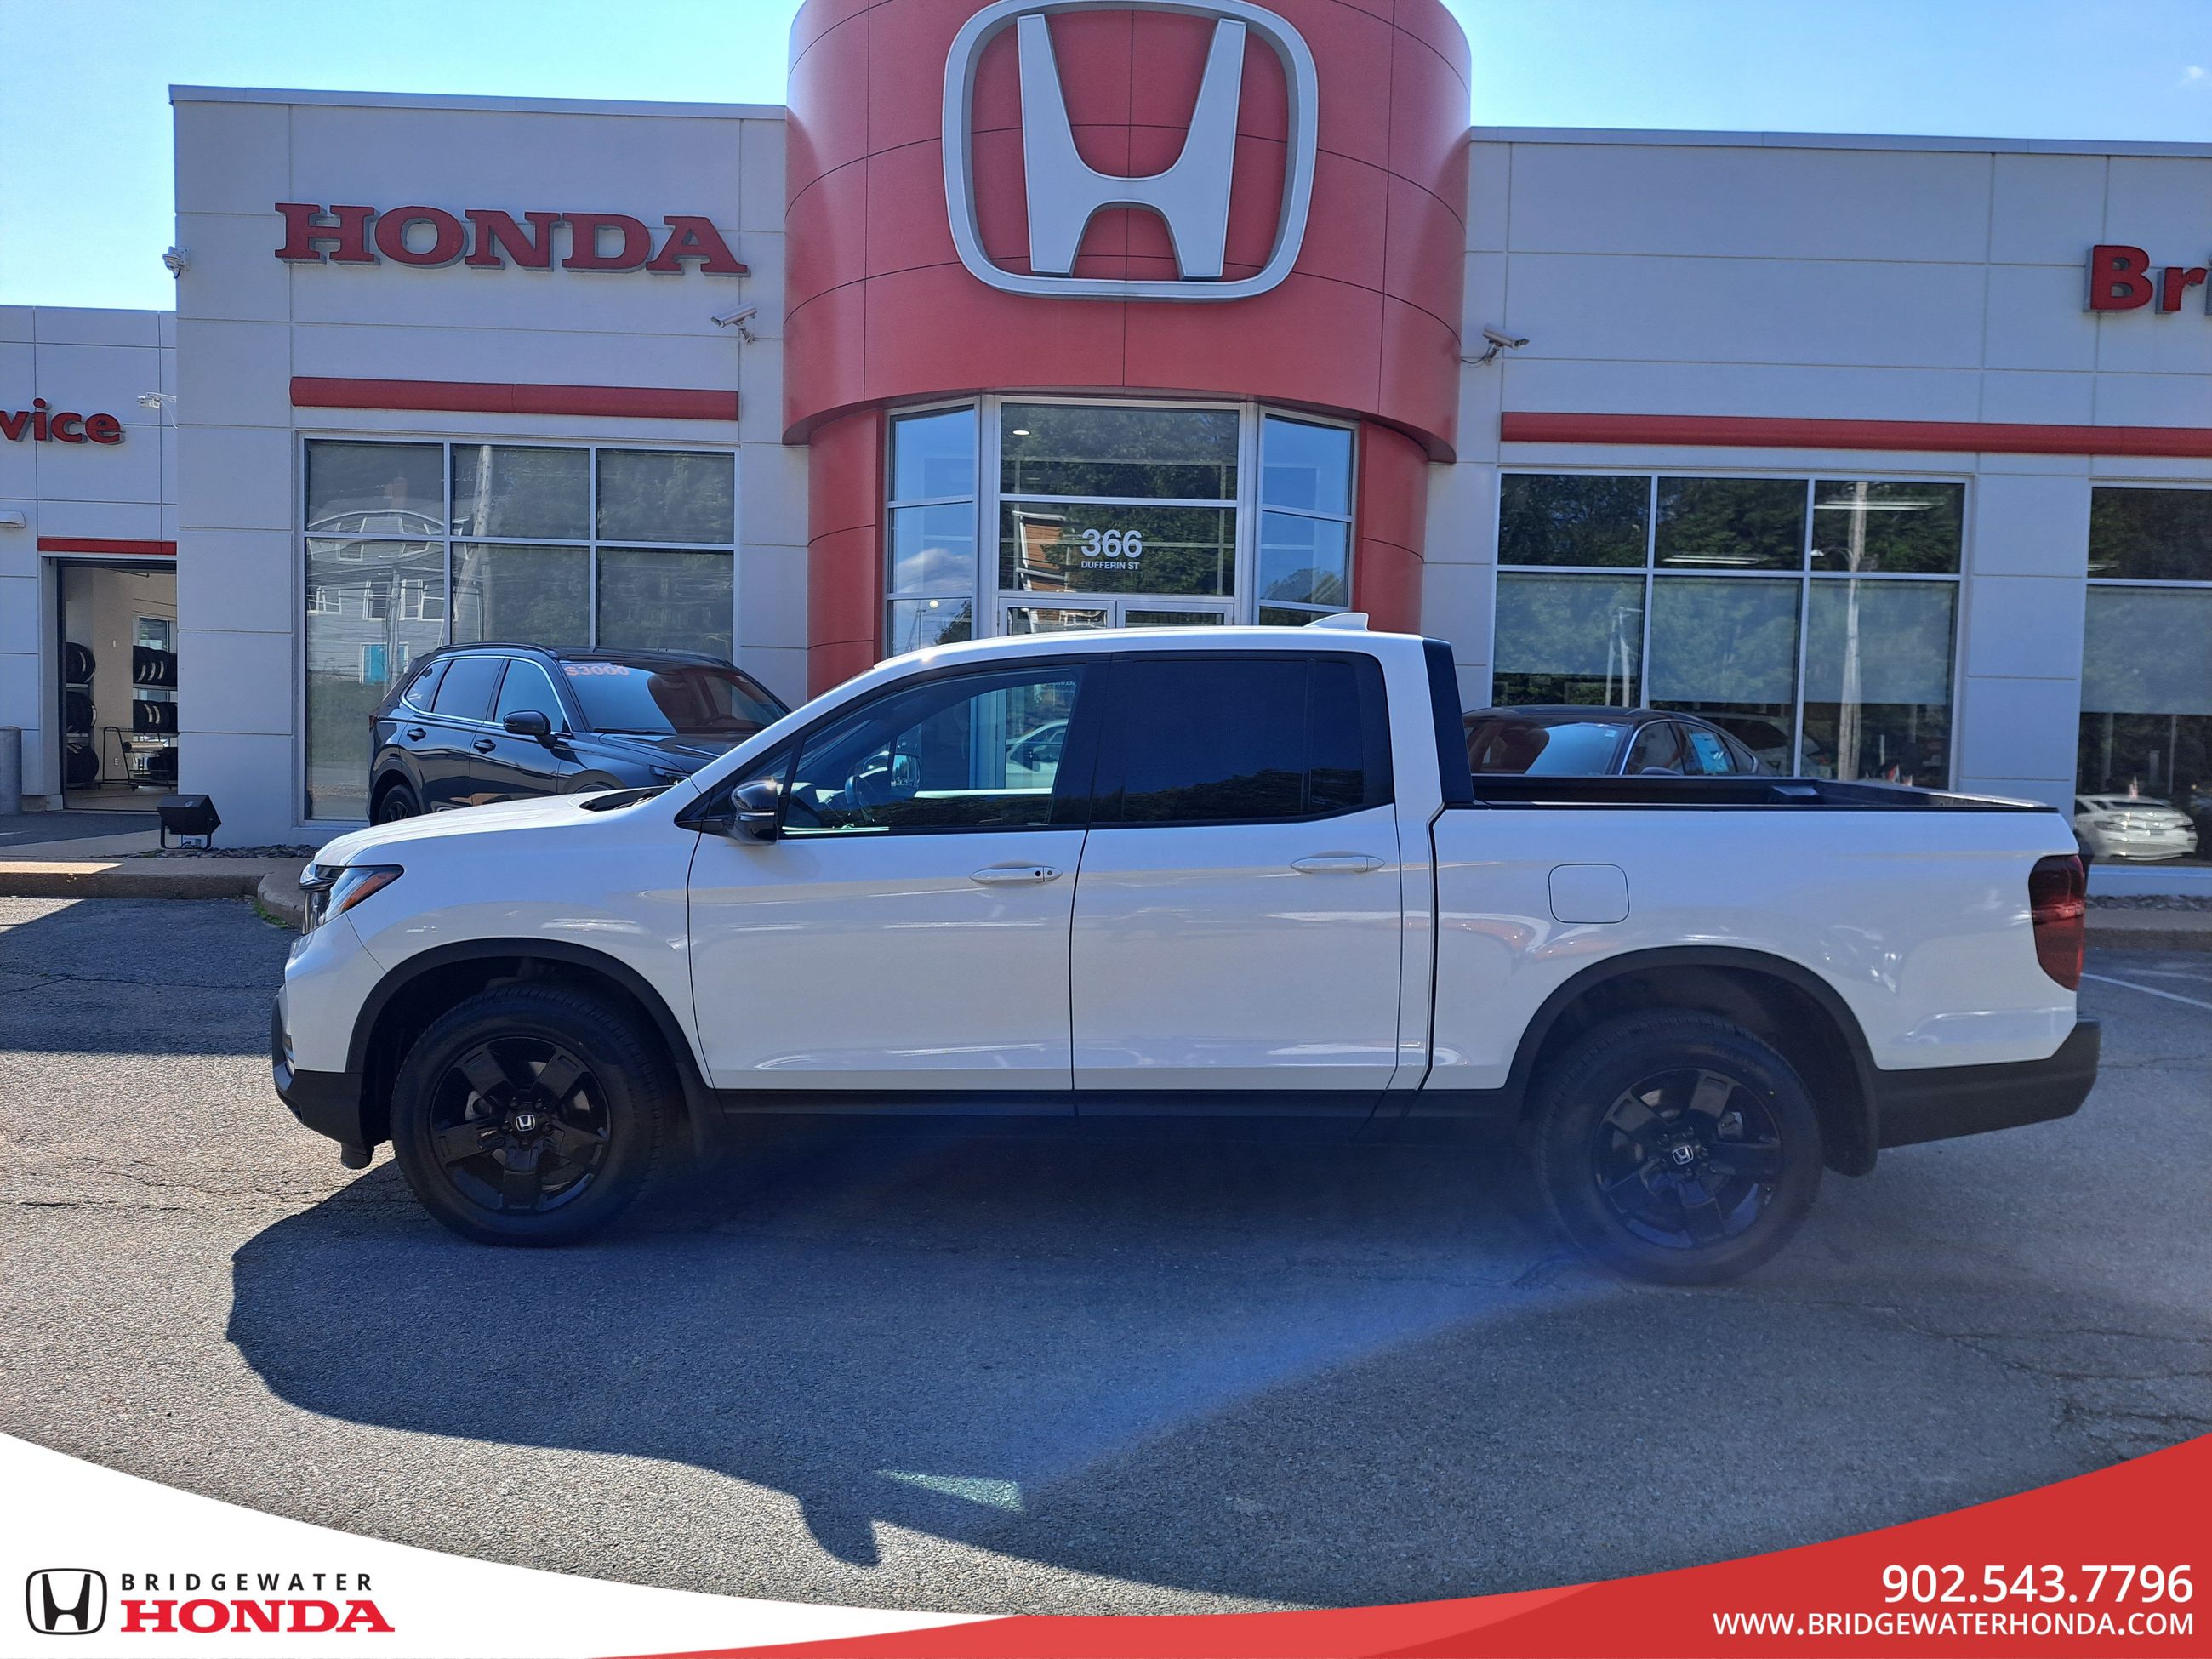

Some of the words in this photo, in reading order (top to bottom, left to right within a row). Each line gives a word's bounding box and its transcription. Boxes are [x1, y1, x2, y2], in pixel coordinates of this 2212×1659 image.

[275, 202, 750, 278] HONDA
[2089, 244, 2212, 313] Br
[1080, 528, 1143, 558] 366
[1080, 561, 1126, 570] DUFFERIN
[1127, 562, 1140, 570] ST
